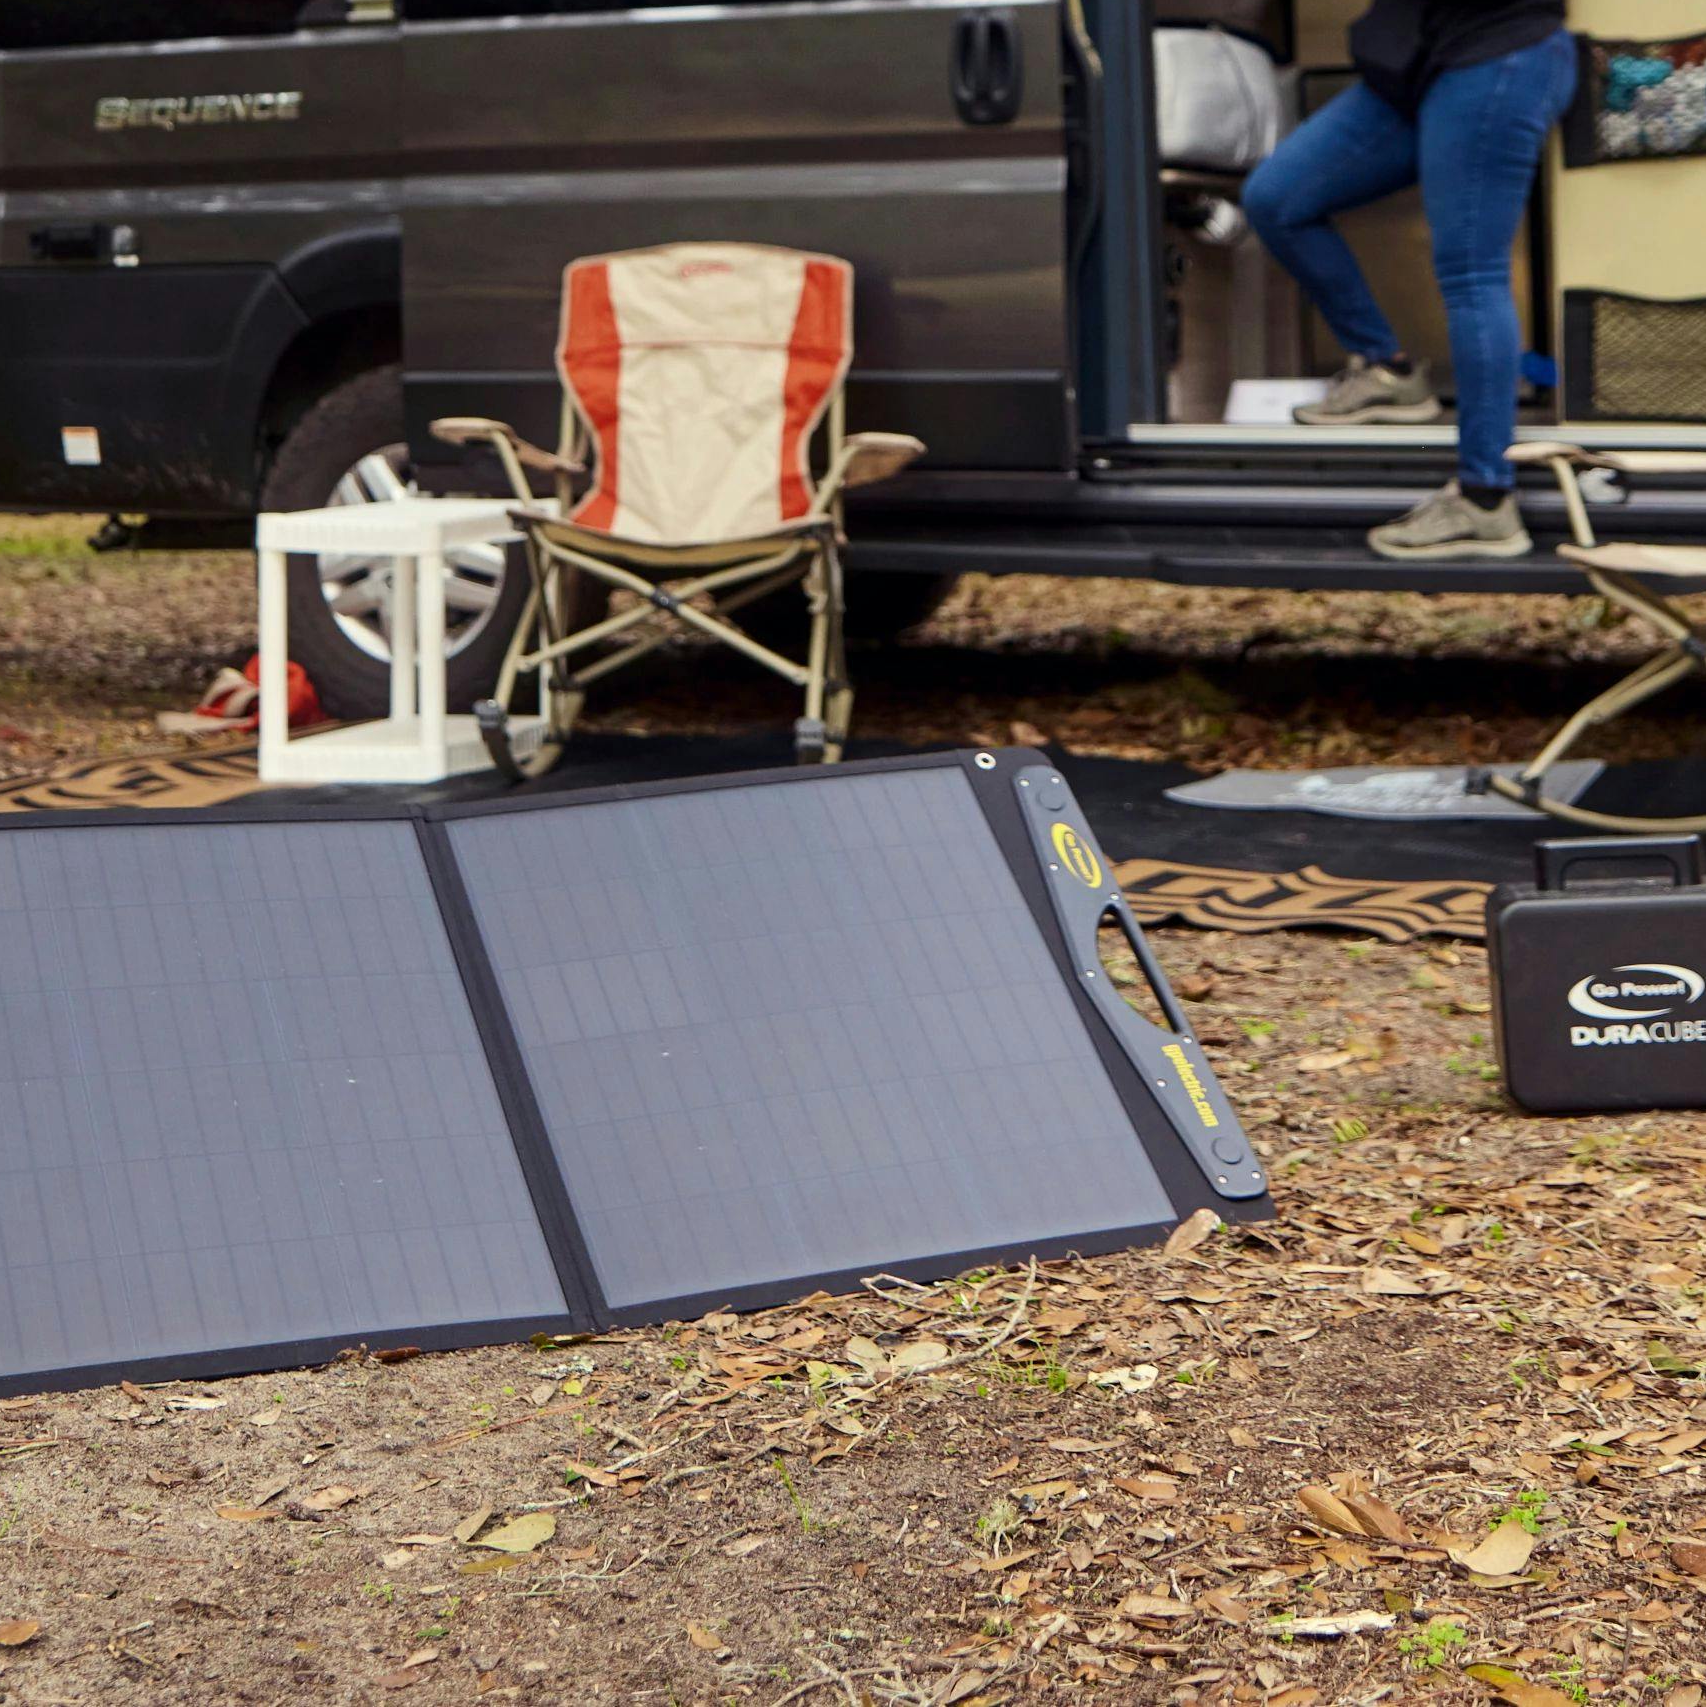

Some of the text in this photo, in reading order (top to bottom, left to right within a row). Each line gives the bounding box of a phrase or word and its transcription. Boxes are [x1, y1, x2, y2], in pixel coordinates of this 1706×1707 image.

[95, 91, 303, 132] SEQUENCE
[1590, 980, 1686, 998] Go Power!
[1161, 1044, 1220, 1127] gpelectric.com
